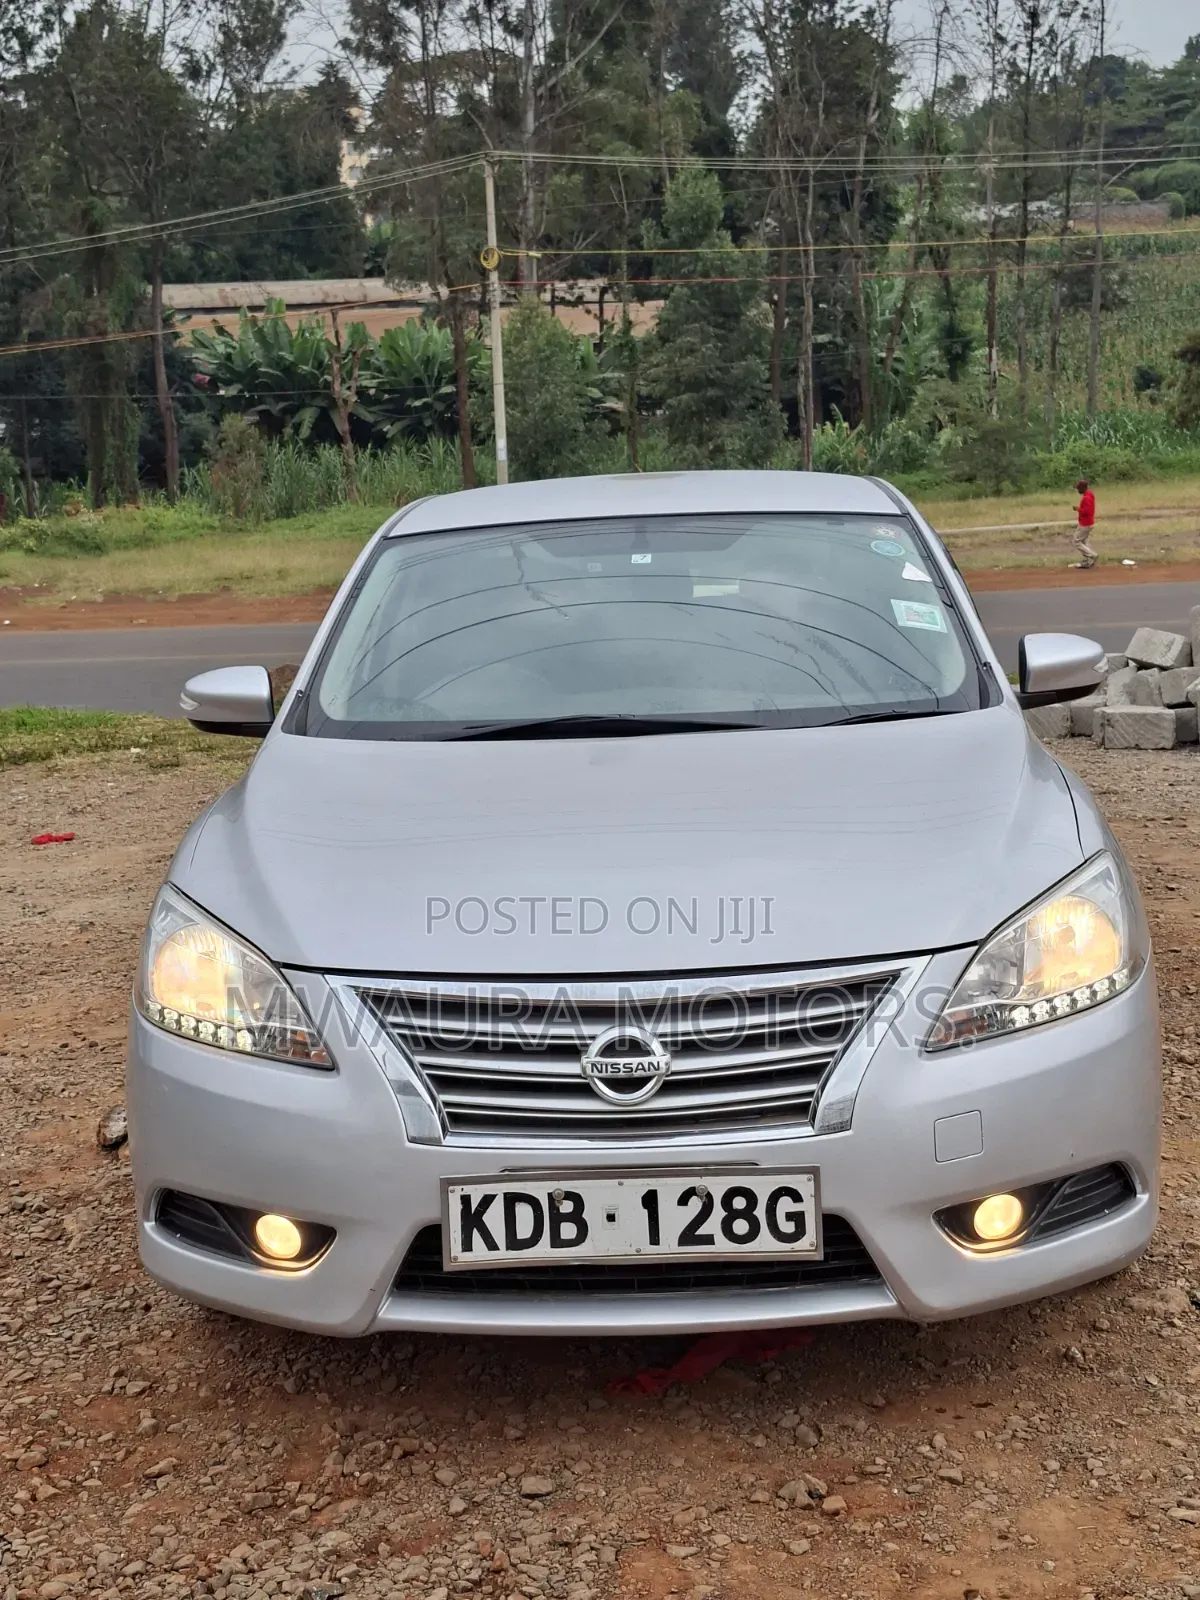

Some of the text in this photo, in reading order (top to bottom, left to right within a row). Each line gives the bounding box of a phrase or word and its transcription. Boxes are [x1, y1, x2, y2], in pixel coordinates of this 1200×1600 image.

[590, 1060, 661, 1075] NISSAN
[460, 1185, 807, 1253] KDB 128G
